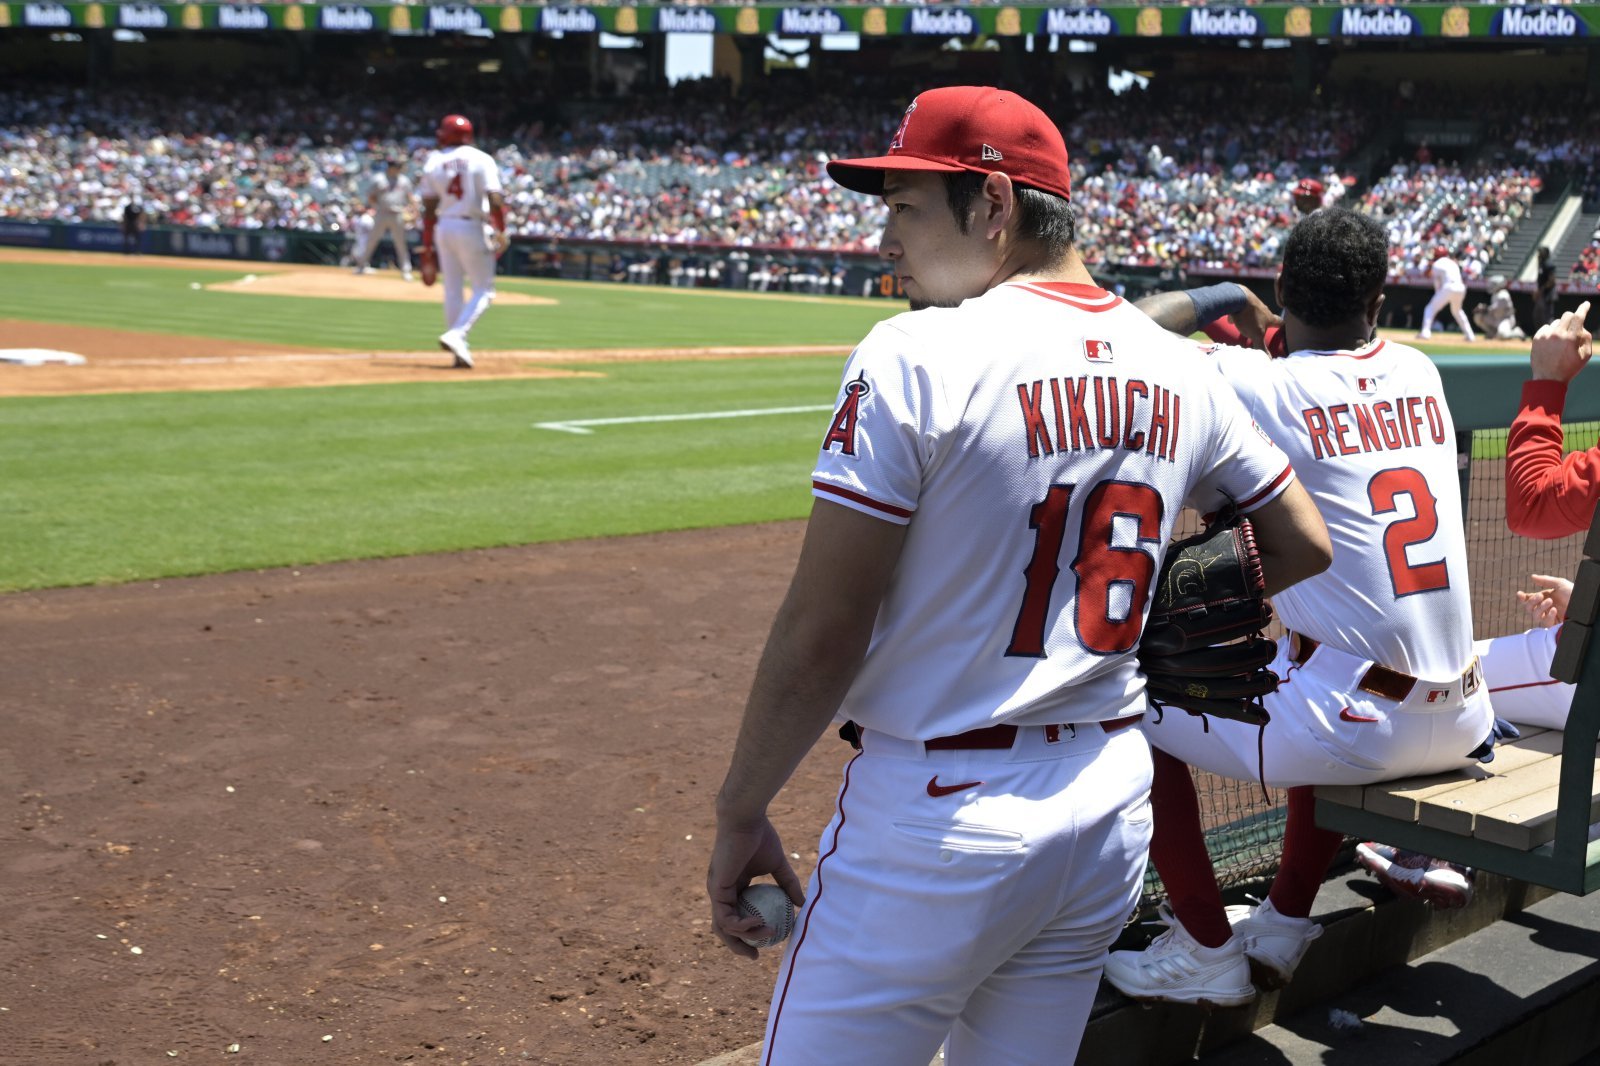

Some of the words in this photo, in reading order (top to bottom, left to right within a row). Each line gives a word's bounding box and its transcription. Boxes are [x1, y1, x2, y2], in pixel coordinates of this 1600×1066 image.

[782, 8, 841, 33] Modelo
[911, 8, 972, 34] Modelo
[1047, 8, 1111, 34] Modelo
[1190, 8, 1257, 35] Modelo
[1342, 8, 1412, 35] Modelo
[1502, 8, 1576, 35] Modelo
[447, 172, 464, 201] 4
[822, 369, 870, 457] A
[1017, 375, 1180, 463] KIKUCHI
[1302, 395, 1445, 460] RENGIFO
[1367, 466, 1450, 600] 2
[1004, 479, 1165, 658] 16
